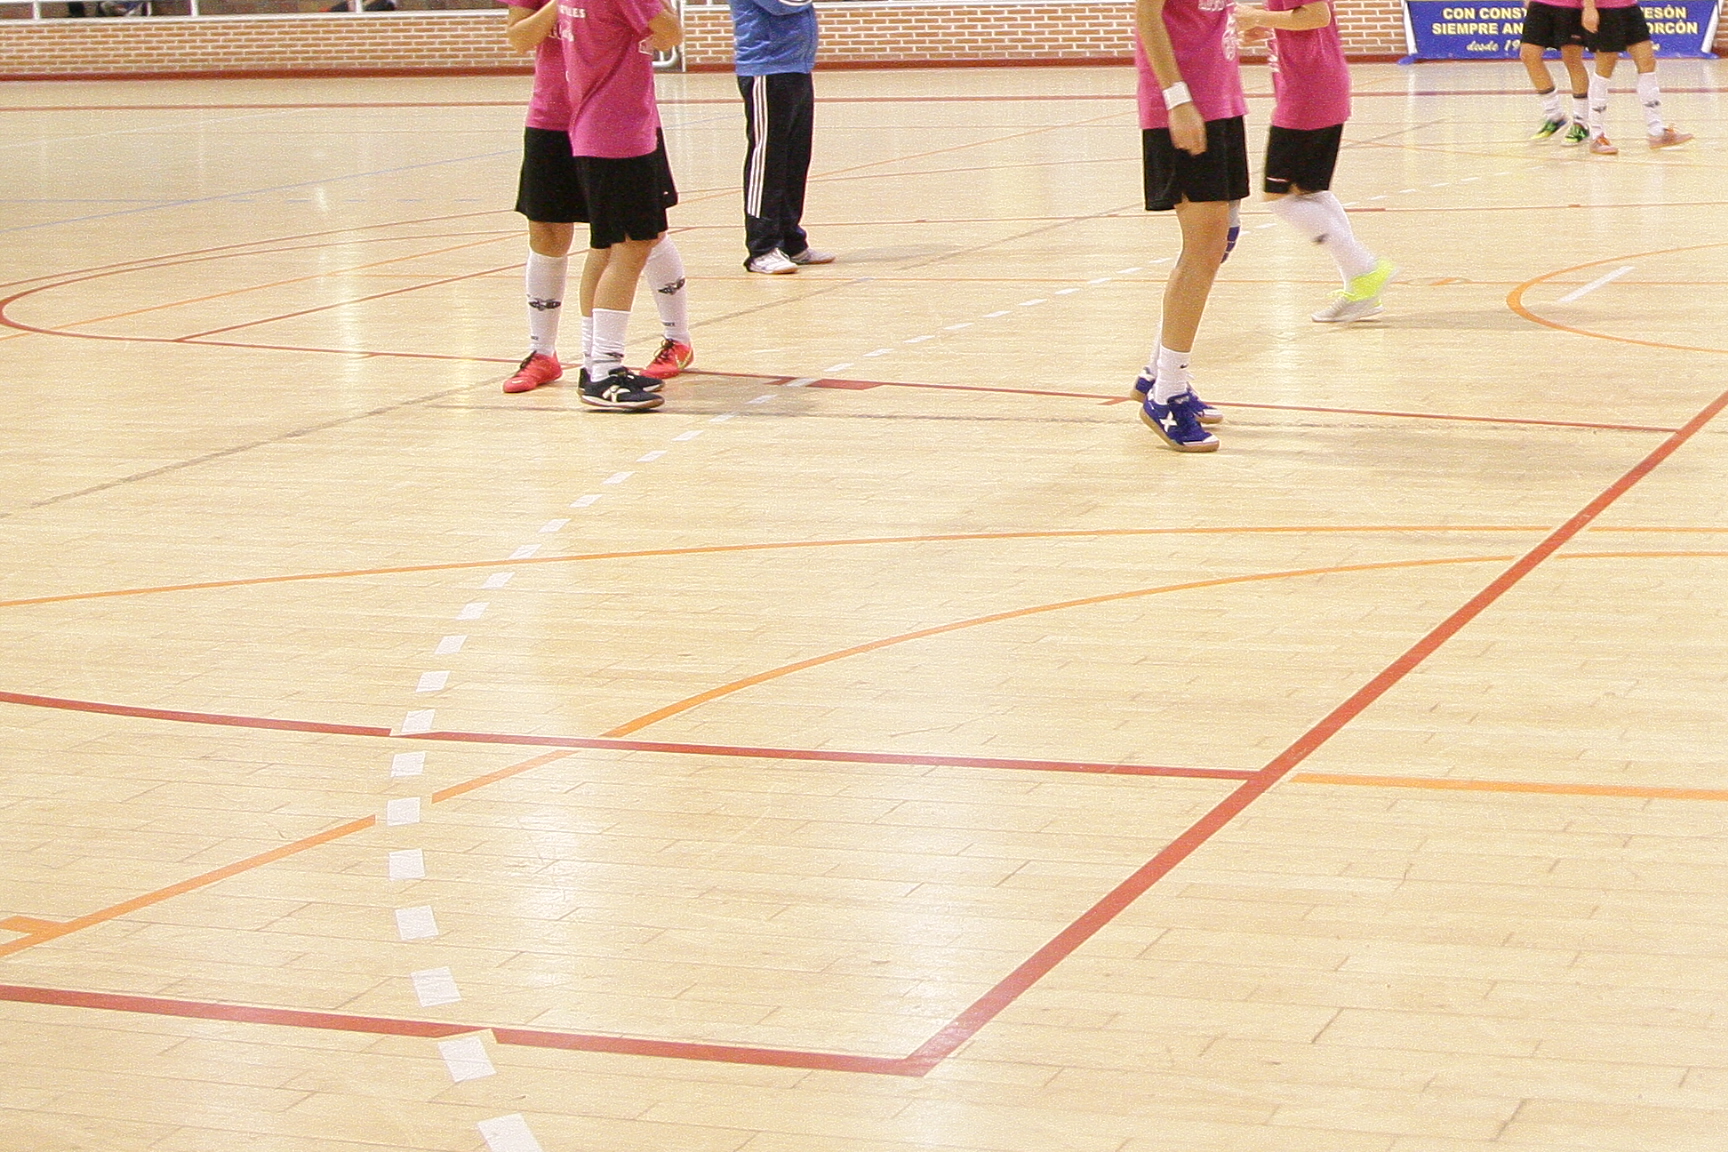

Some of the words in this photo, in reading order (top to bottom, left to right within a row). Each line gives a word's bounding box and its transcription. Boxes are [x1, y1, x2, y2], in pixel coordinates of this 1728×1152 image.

[1442, 7, 1476, 20] CON
[1479, 7, 1527, 20] CONST
[1641, 4, 1687, 19] ESÓN
[1432, 22, 1499, 35] SIEMPRE
